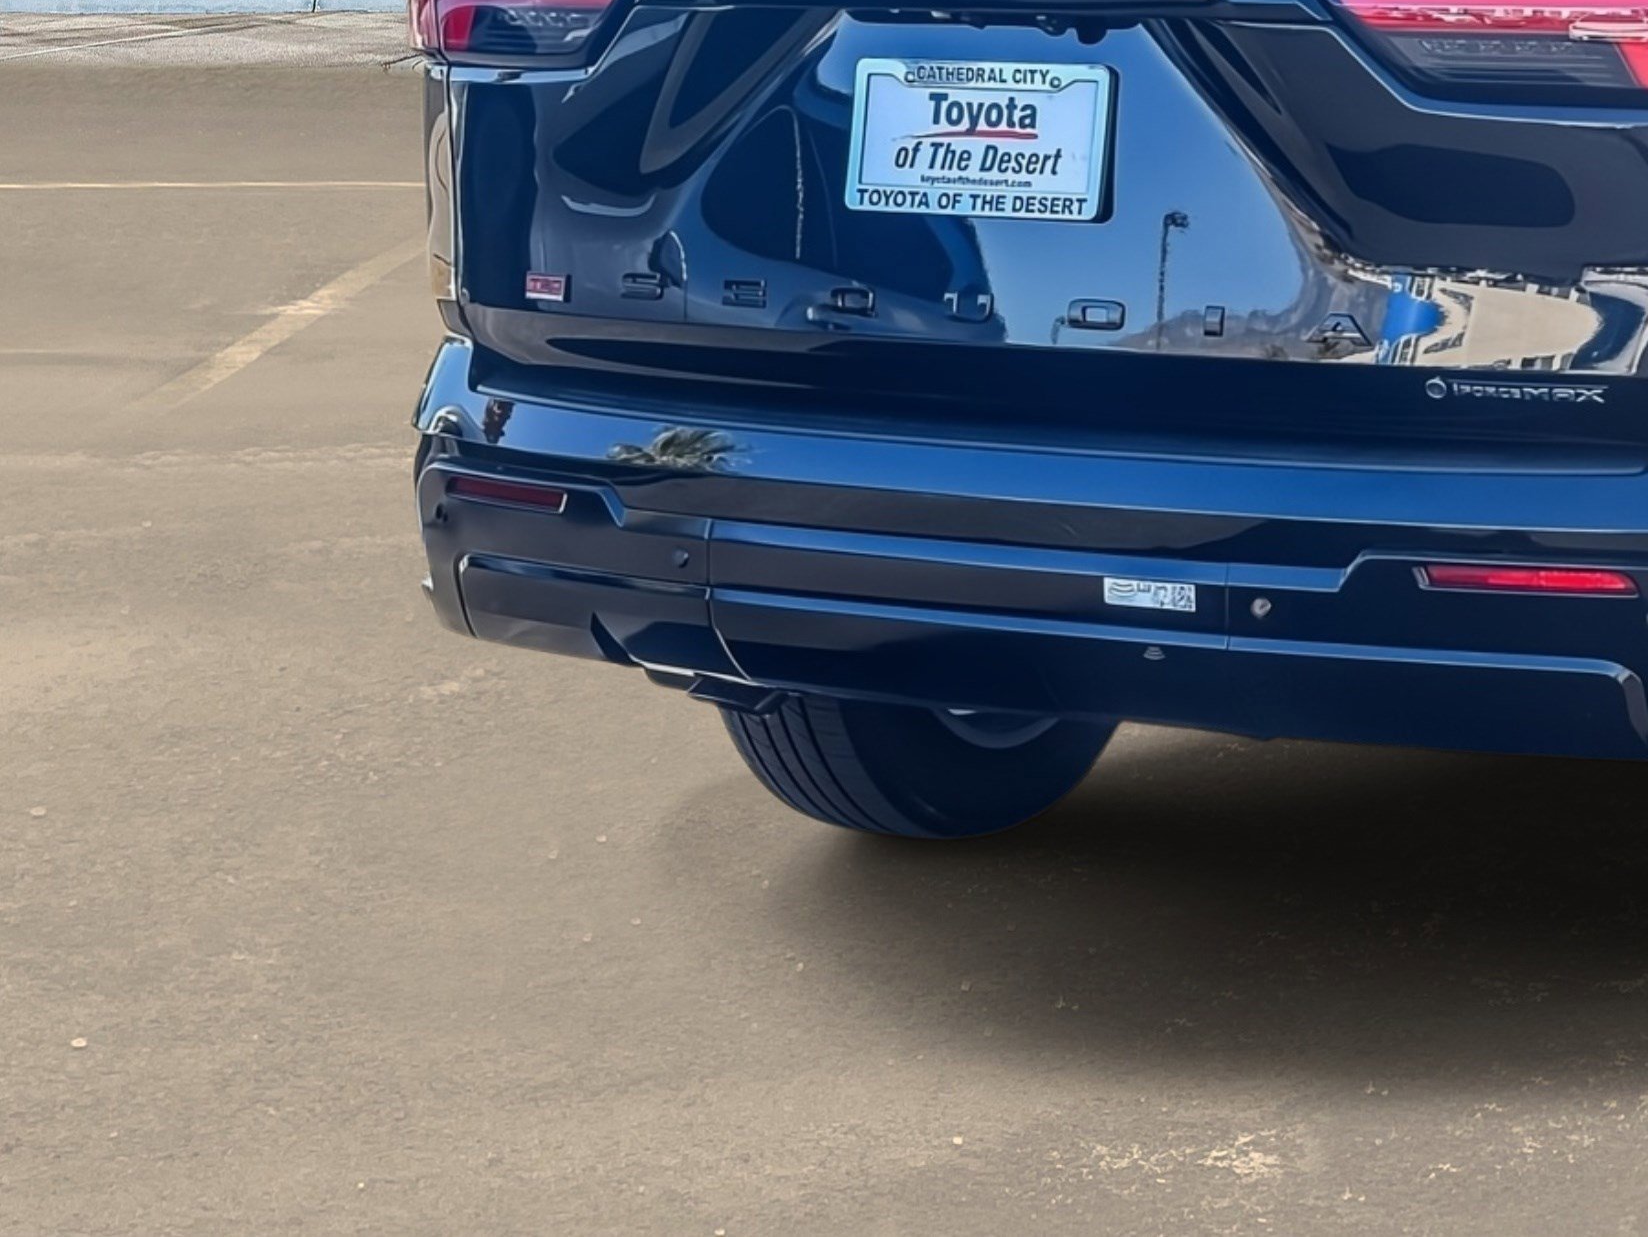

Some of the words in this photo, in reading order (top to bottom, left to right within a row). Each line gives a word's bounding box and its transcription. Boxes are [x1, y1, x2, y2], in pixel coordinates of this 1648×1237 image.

[916, 65, 1007, 84] CATHEDRAL
[1012, 68, 1050, 86] CITY
[929, 92, 1037, 133] Toyota
[894, 141, 922, 169] of
[928, 141, 972, 172] The
[979, 144, 1062, 176] Desert
[856, 188, 930, 209] TOYOTA
[937, 192, 963, 211] OF
[968, 194, 1006, 212] THE
[1011, 196, 1088, 215] DESERT
